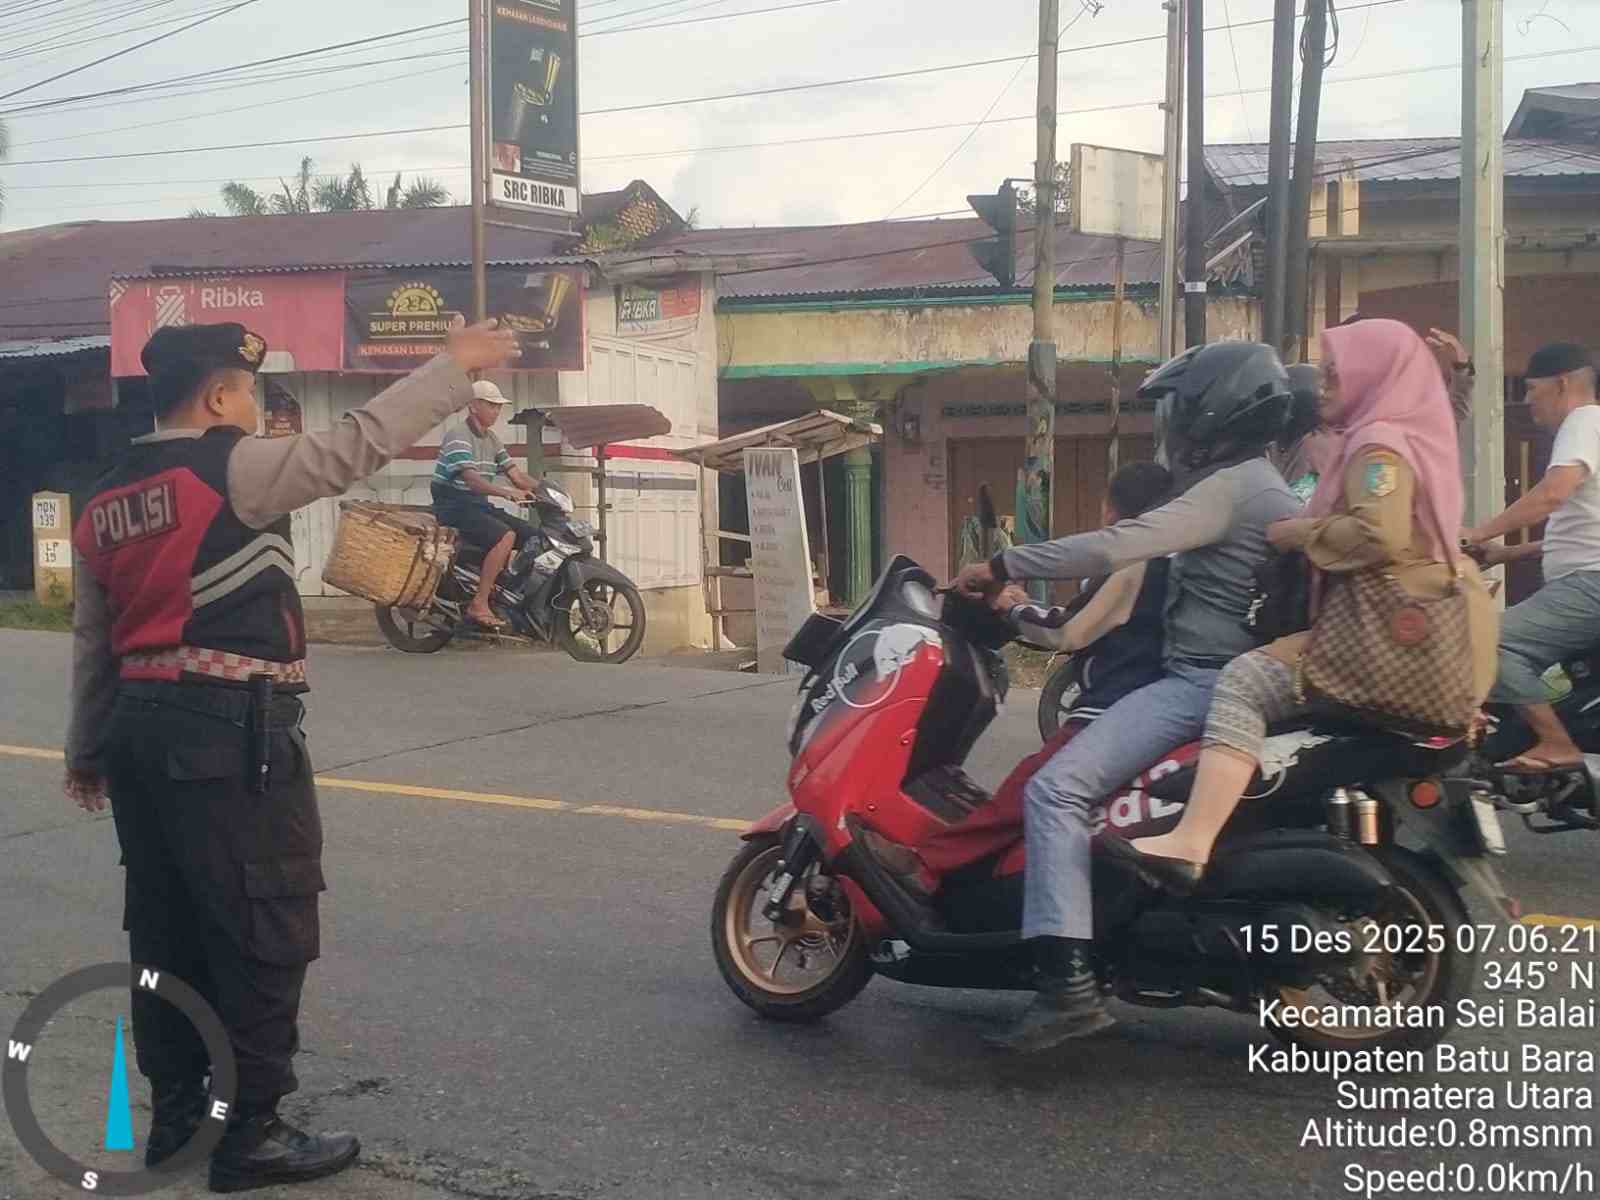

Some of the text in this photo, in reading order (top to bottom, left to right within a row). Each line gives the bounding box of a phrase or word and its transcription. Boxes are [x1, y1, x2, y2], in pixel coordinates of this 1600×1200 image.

[504, 179, 566, 209] SRC RIBKA
[200, 286, 265, 309] Ribka
[369, 319, 452, 333] SUPER PREMIU
[93, 485, 172, 547] POLISI
